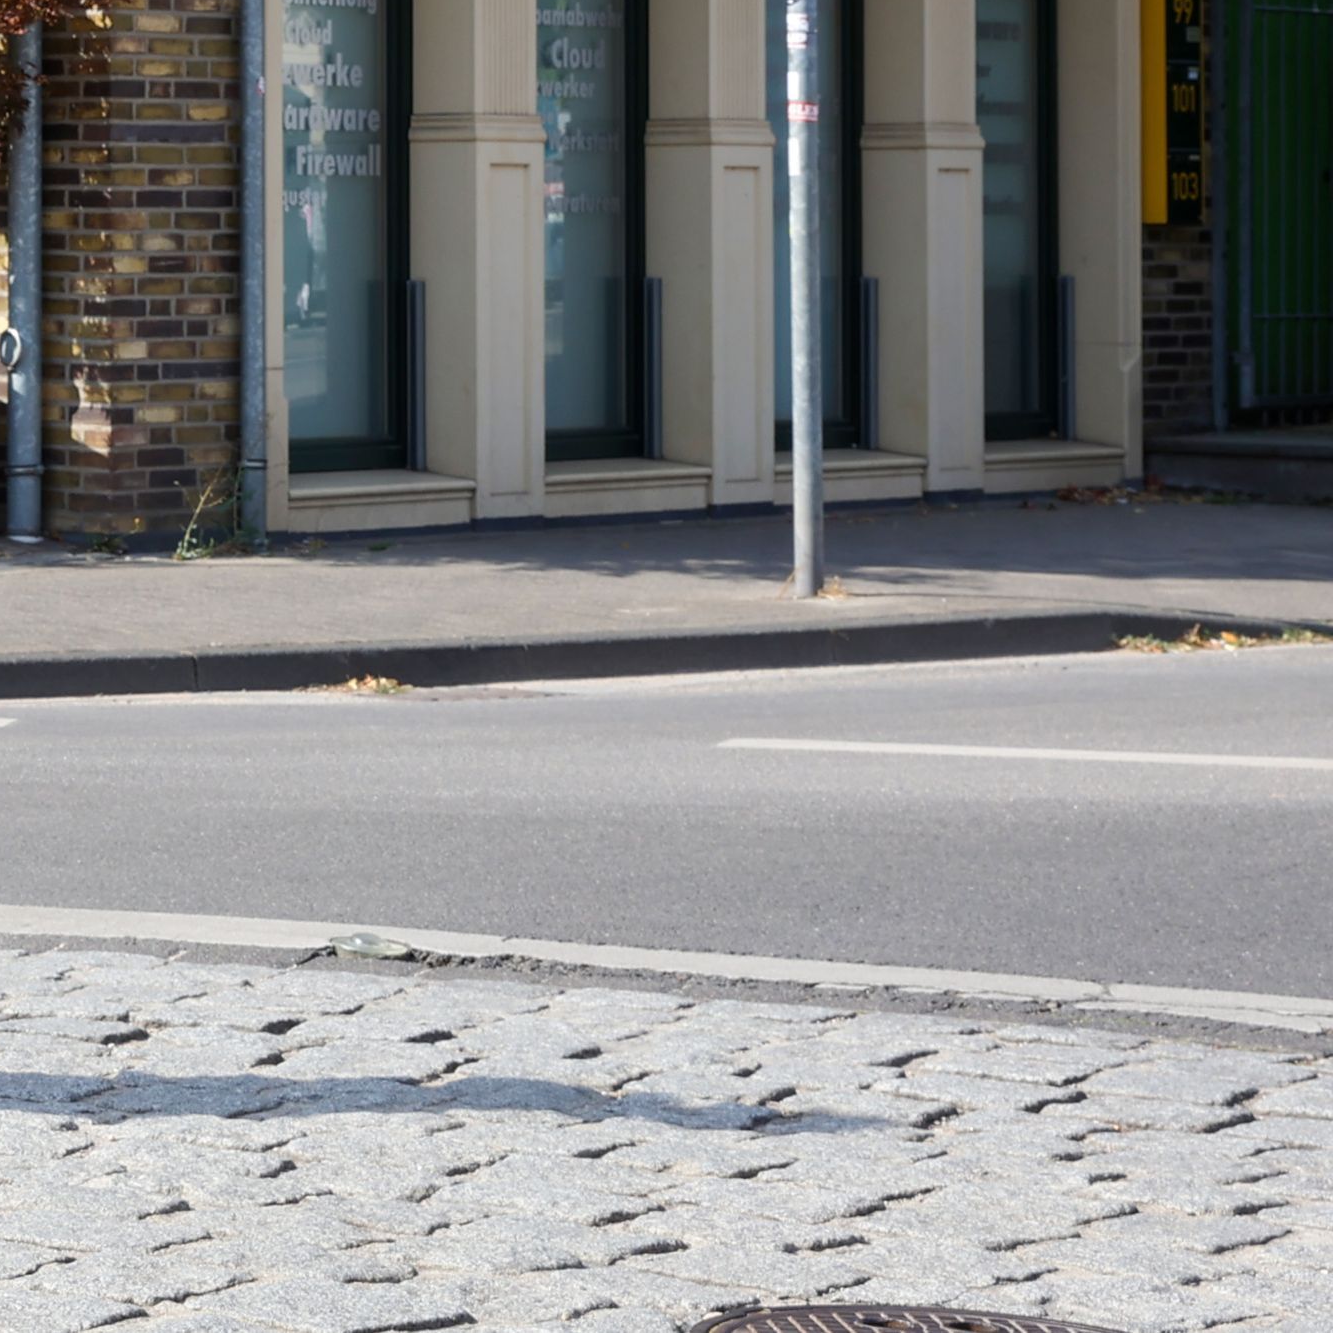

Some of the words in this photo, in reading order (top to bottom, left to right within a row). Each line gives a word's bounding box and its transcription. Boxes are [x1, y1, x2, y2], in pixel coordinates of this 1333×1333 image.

[550, 36, 606, 70] Cloud
[1172, 84, 1196, 113] 101
[296, 144, 382, 176] Firewall
[1172, 171, 1199, 200] 103
